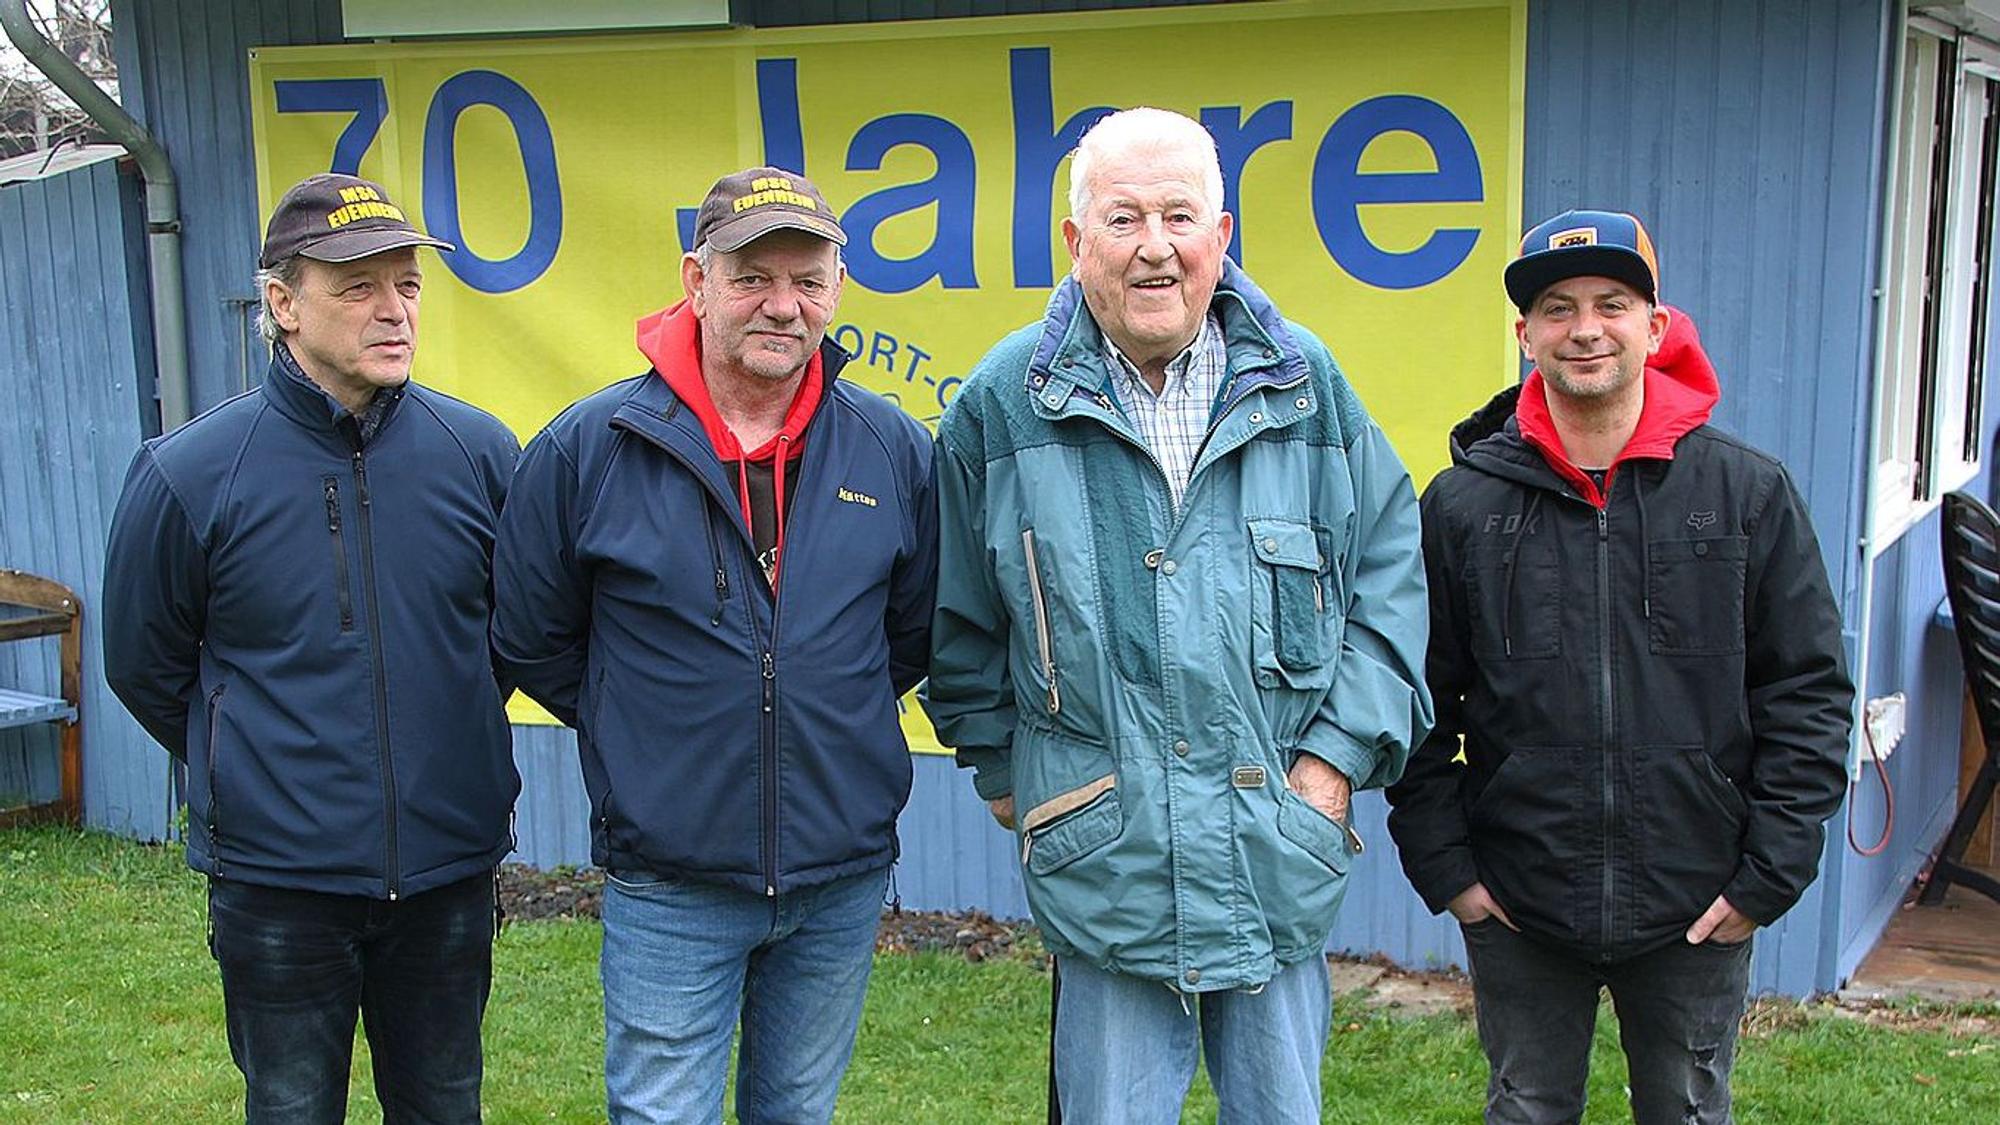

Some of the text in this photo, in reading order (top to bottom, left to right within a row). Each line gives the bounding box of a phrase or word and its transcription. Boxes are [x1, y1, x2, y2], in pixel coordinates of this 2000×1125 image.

[274, 47, 1484, 294] 70 Jahre
[834, 323, 963, 409] ORT-C
